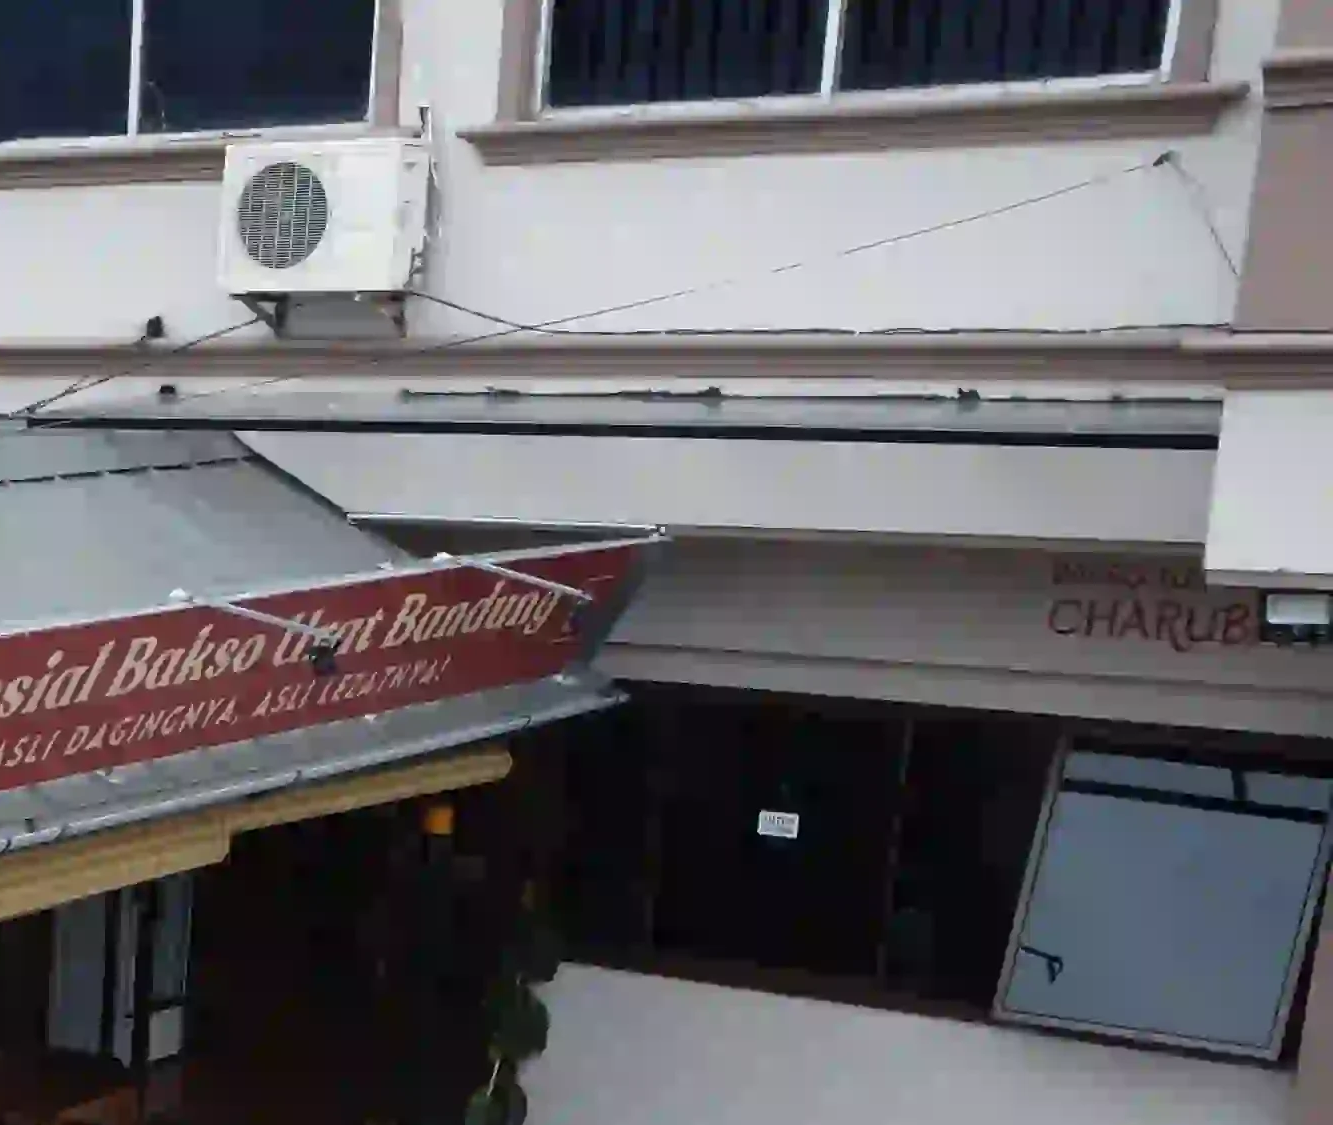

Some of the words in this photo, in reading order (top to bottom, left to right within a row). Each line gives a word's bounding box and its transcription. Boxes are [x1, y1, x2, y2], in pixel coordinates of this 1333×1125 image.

[106, 624, 266, 697] Bakso
[381, 580, 561, 650] Bandung
[252, 679, 316, 718] ASLI
